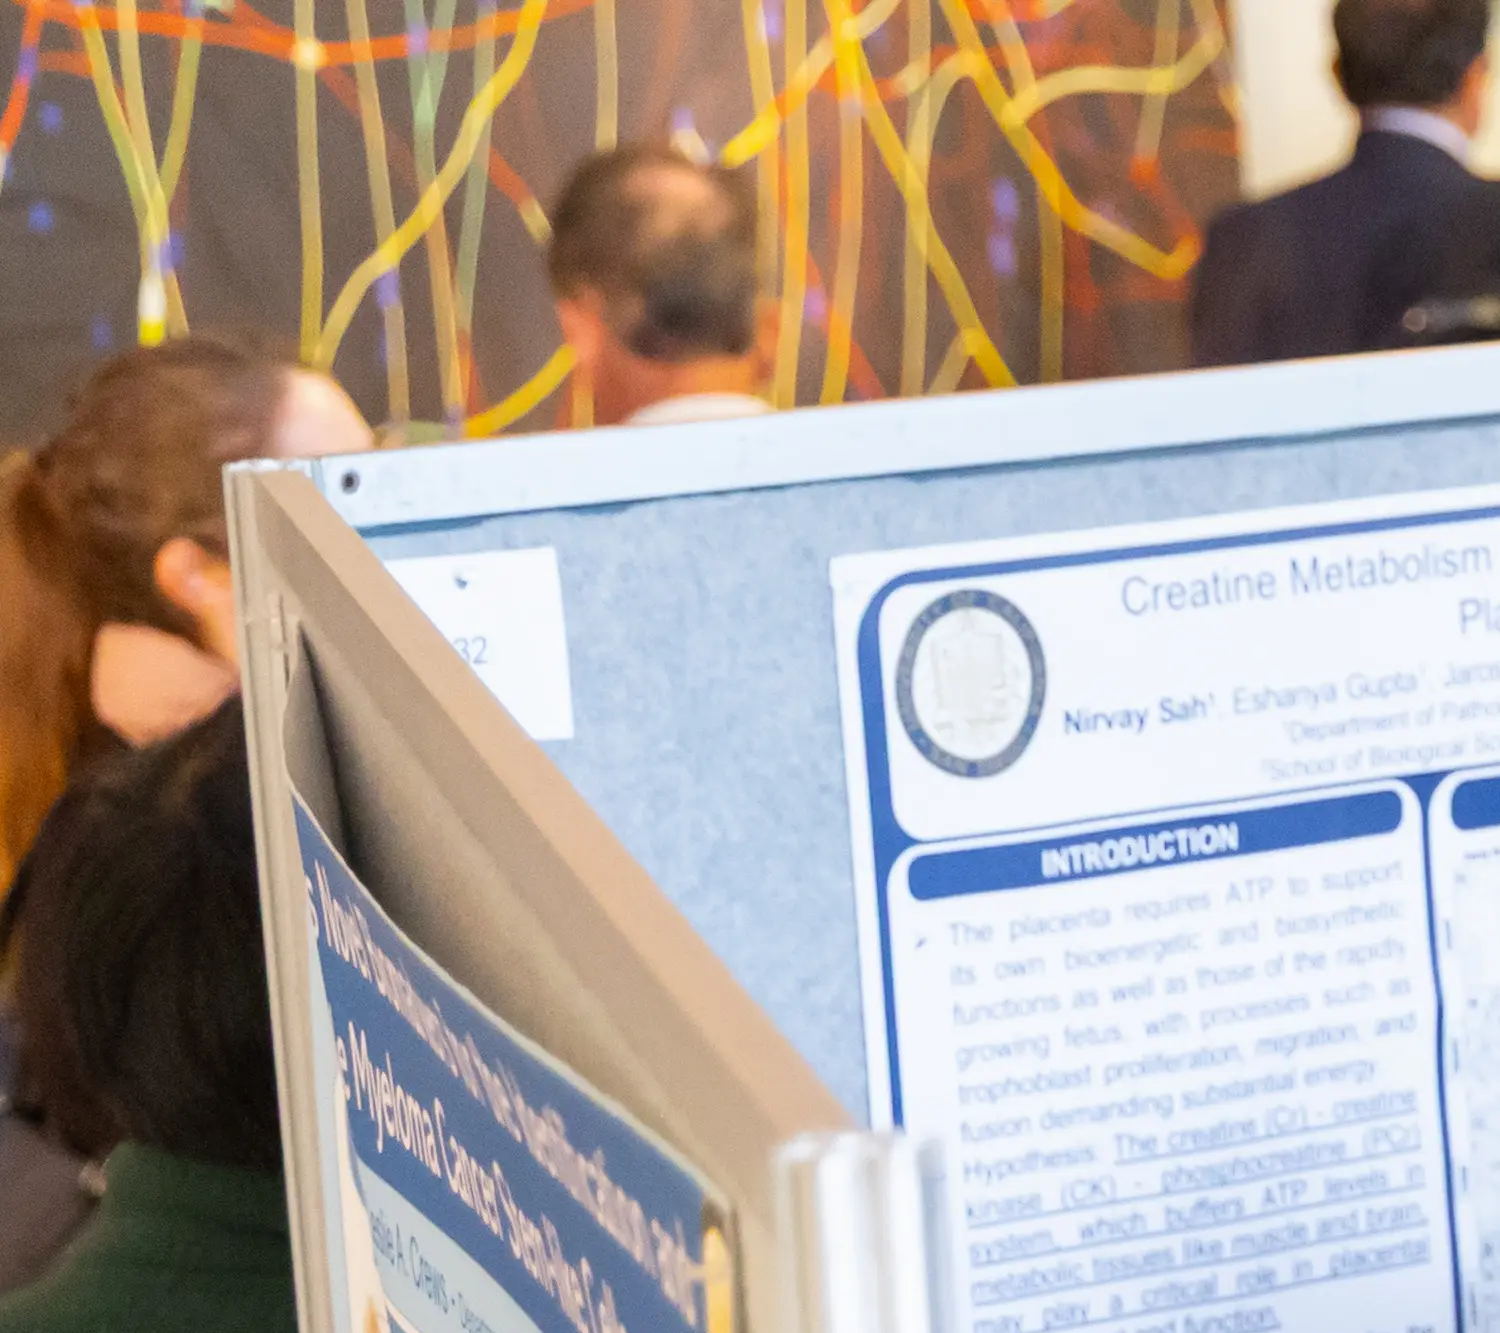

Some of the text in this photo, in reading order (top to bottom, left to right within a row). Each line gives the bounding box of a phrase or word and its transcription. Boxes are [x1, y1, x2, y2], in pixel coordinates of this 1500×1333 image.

[1118, 559, 1279, 618] Creatine
[1287, 534, 1493, 597] Metabolism
[1060, 701, 1151, 744] Nirvay
[1041, 822, 1240, 879] INTRODUCTION
[948, 856, 1404, 948] The placenta requires ATP to support
[949, 896, 1401, 990] its own bioenergetic and biosynthetic
[952, 933, 1405, 1029] functions as well as those of the rapidly
[955, 1031, 1051, 1074] growing
[1144, 1008, 1187, 1036] with
[1200, 994, 1310, 1032] processes
[1322, 977, 1373, 1006] such
[1388, 977, 1411, 995] as
[957, 1063, 1093, 1113] trophoblast
[1374, 1007, 1417, 1036] and
[959, 1059, 1375, 1148] fusion demanding substantial energy
[346, 1020, 444, 1179] Myeloma
[436, 1097, 505, 1240] Cancer
